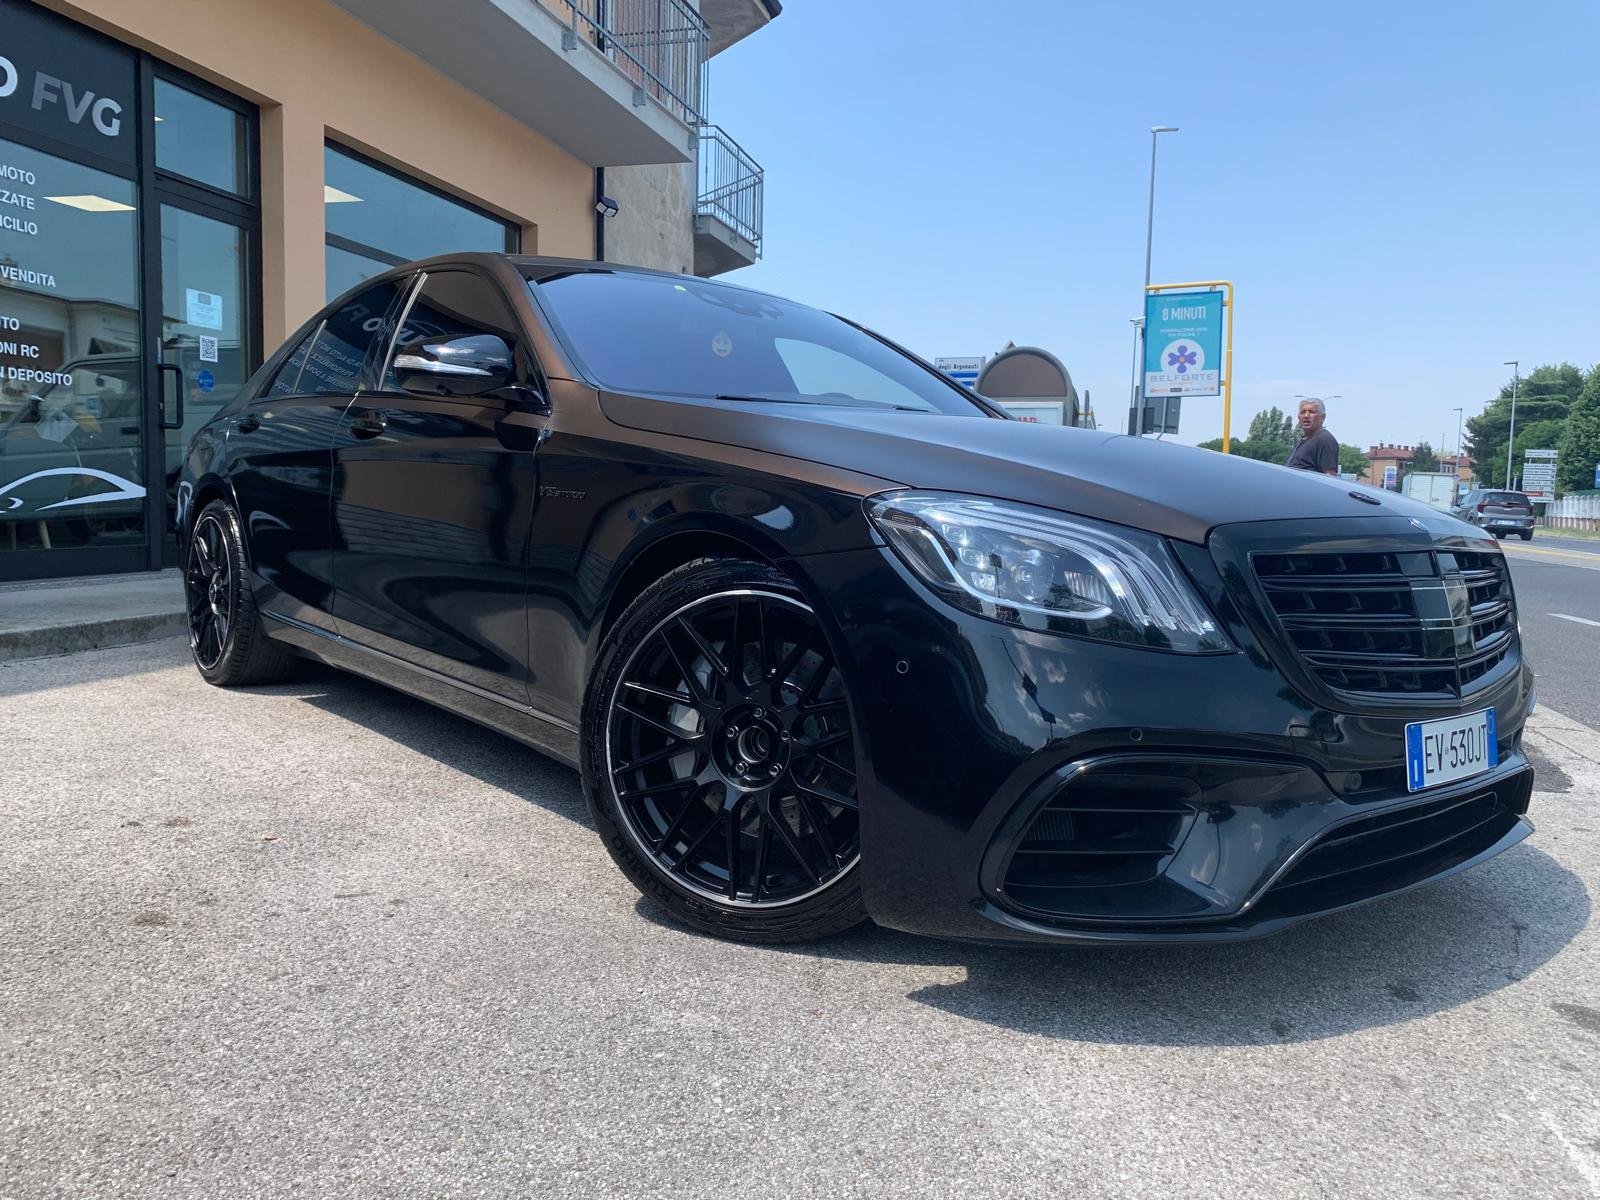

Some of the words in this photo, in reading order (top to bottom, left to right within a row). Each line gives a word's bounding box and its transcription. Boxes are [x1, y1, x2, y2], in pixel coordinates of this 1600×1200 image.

[31, 71, 123, 137] FVG
[0, 189, 36, 210] ZATE
[0, 265, 56, 288] VENDITA
[1162, 307, 1169, 321] 8
[1171, 306, 1206, 321] MINUTI
[20, 344, 39, 358] RC
[8, 367, 73, 386] DEPOSITO
[953, 363, 979, 371] Argonauti
[1150, 373, 1214, 382] BELFORTE
[1424, 733, 1444, 774] EV
[1450, 724, 1487, 769] 530JT
